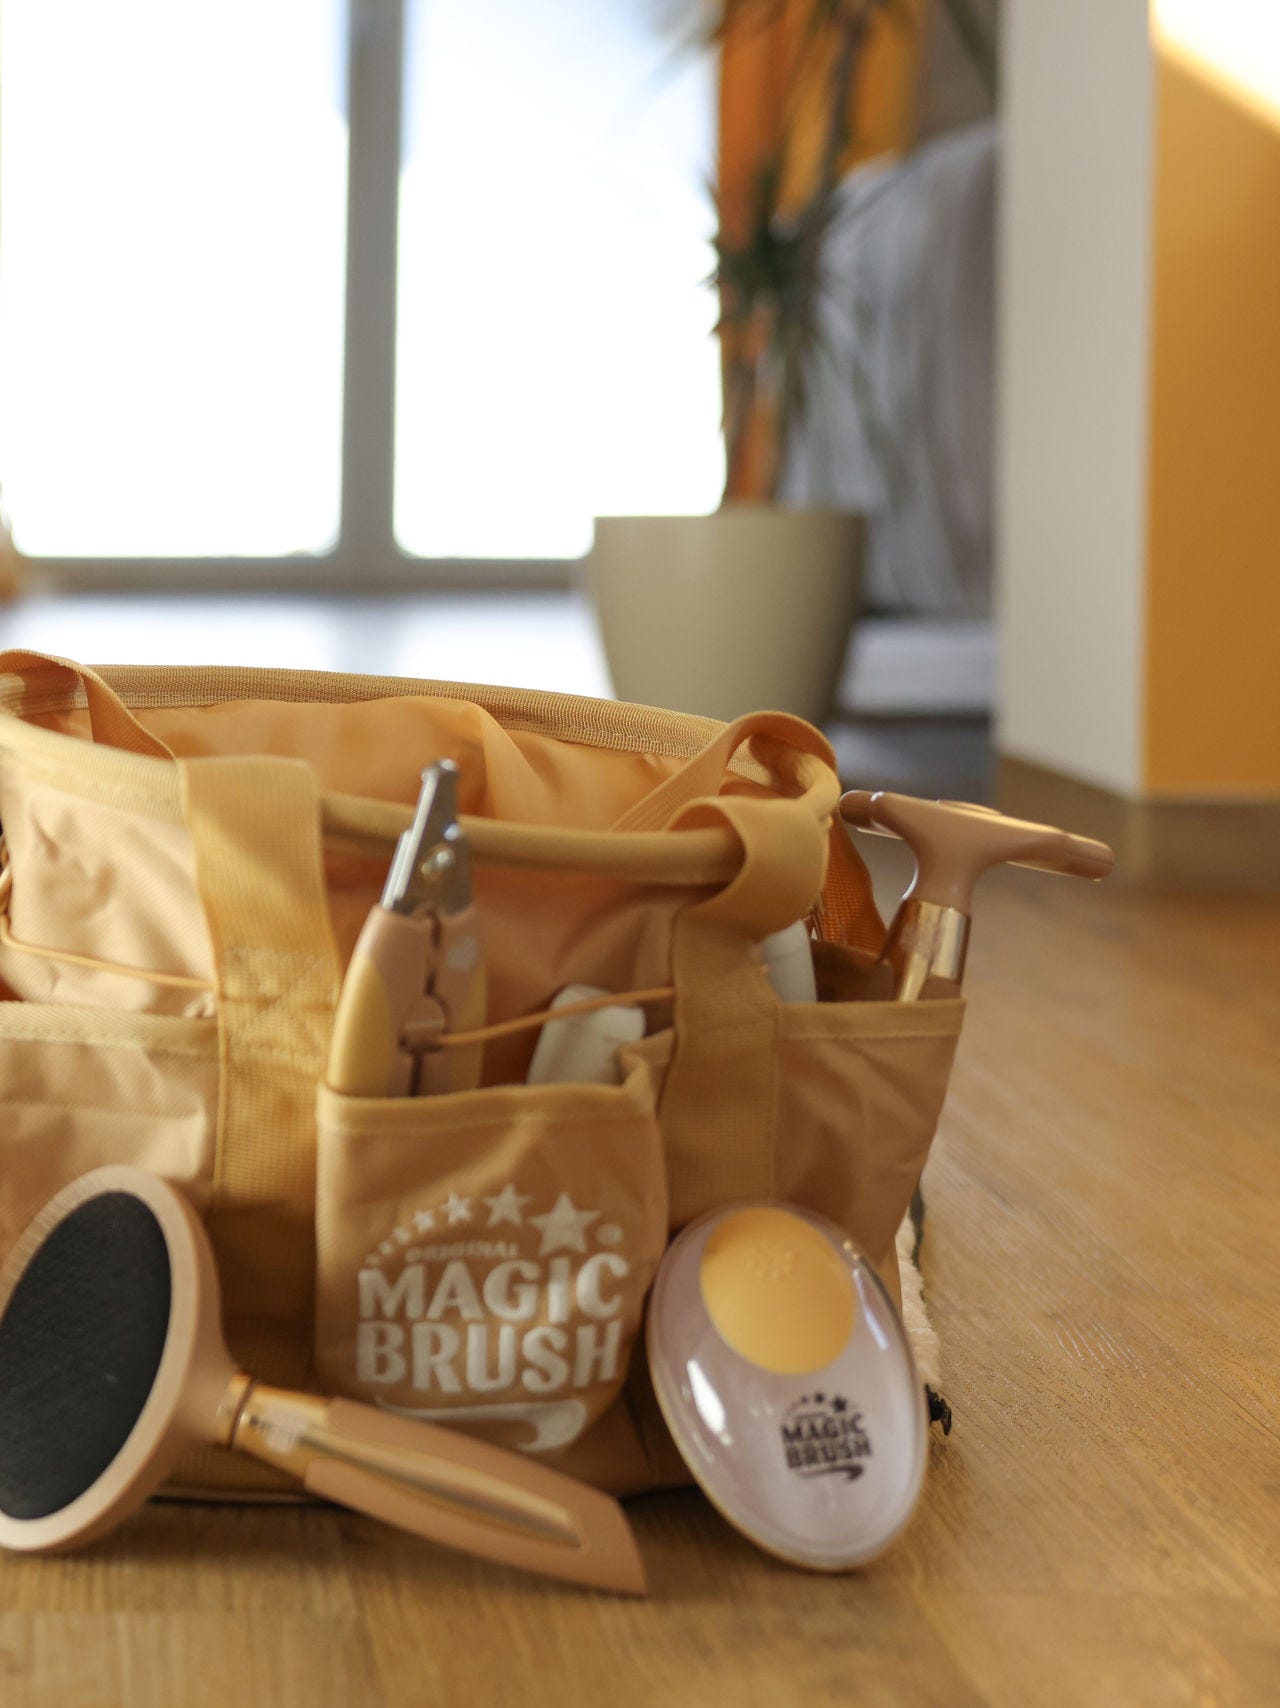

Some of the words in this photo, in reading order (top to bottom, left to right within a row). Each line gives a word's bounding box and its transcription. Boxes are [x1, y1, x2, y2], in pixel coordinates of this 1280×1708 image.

[357, 1252, 629, 1324] MAGIC
[355, 1319, 623, 1393] BRUSH
[781, 1412, 866, 1443] MAGIC
[785, 1436, 873, 1469] BRUSH
